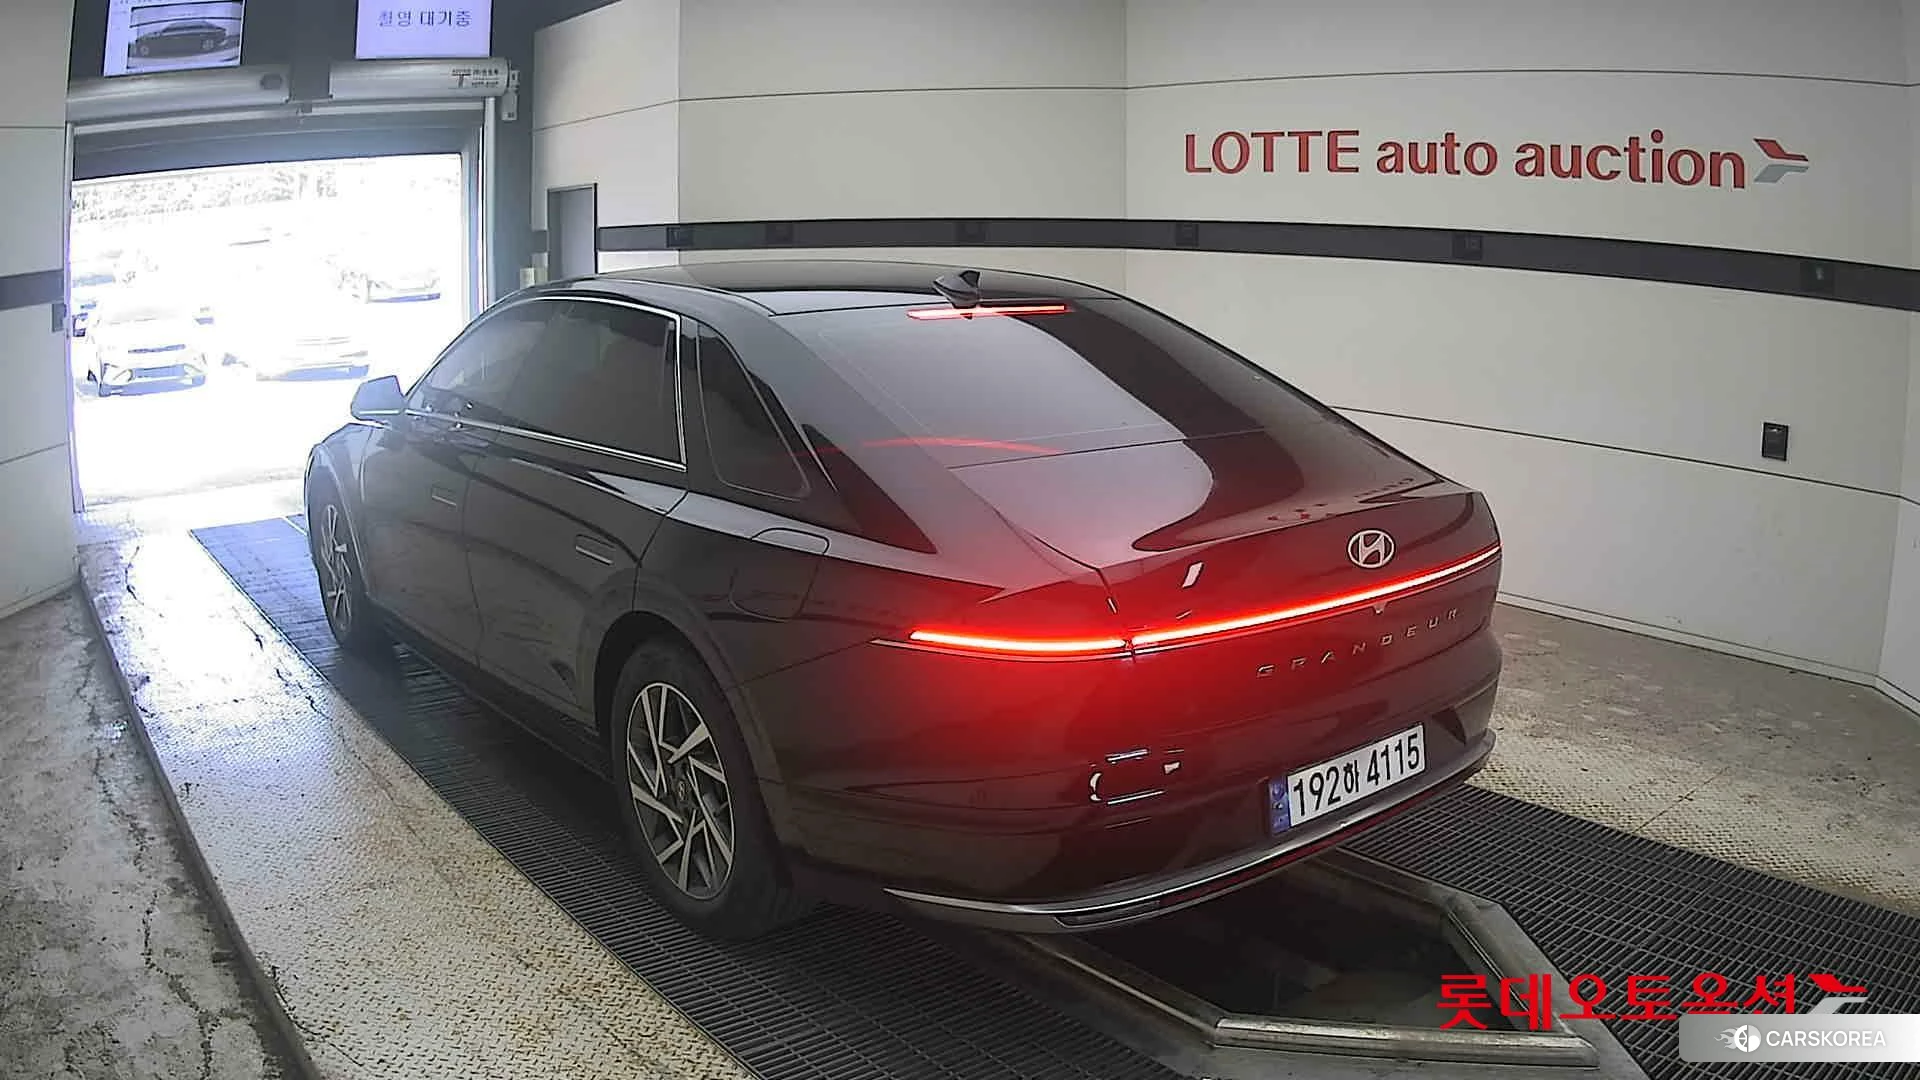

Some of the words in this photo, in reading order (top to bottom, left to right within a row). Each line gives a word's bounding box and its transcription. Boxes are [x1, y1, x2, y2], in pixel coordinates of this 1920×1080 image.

[420, 10, 472, 27] 대기중
[1185, 130, 1360, 174] LOTTE
[1376, 132, 1498, 176] auto
[1514, 129, 1745, 189] auction
[1256, 608, 1458, 678] GRANDEUR
[1293, 760, 1360, 817] 192하
[1366, 733, 1420, 786] 4115
